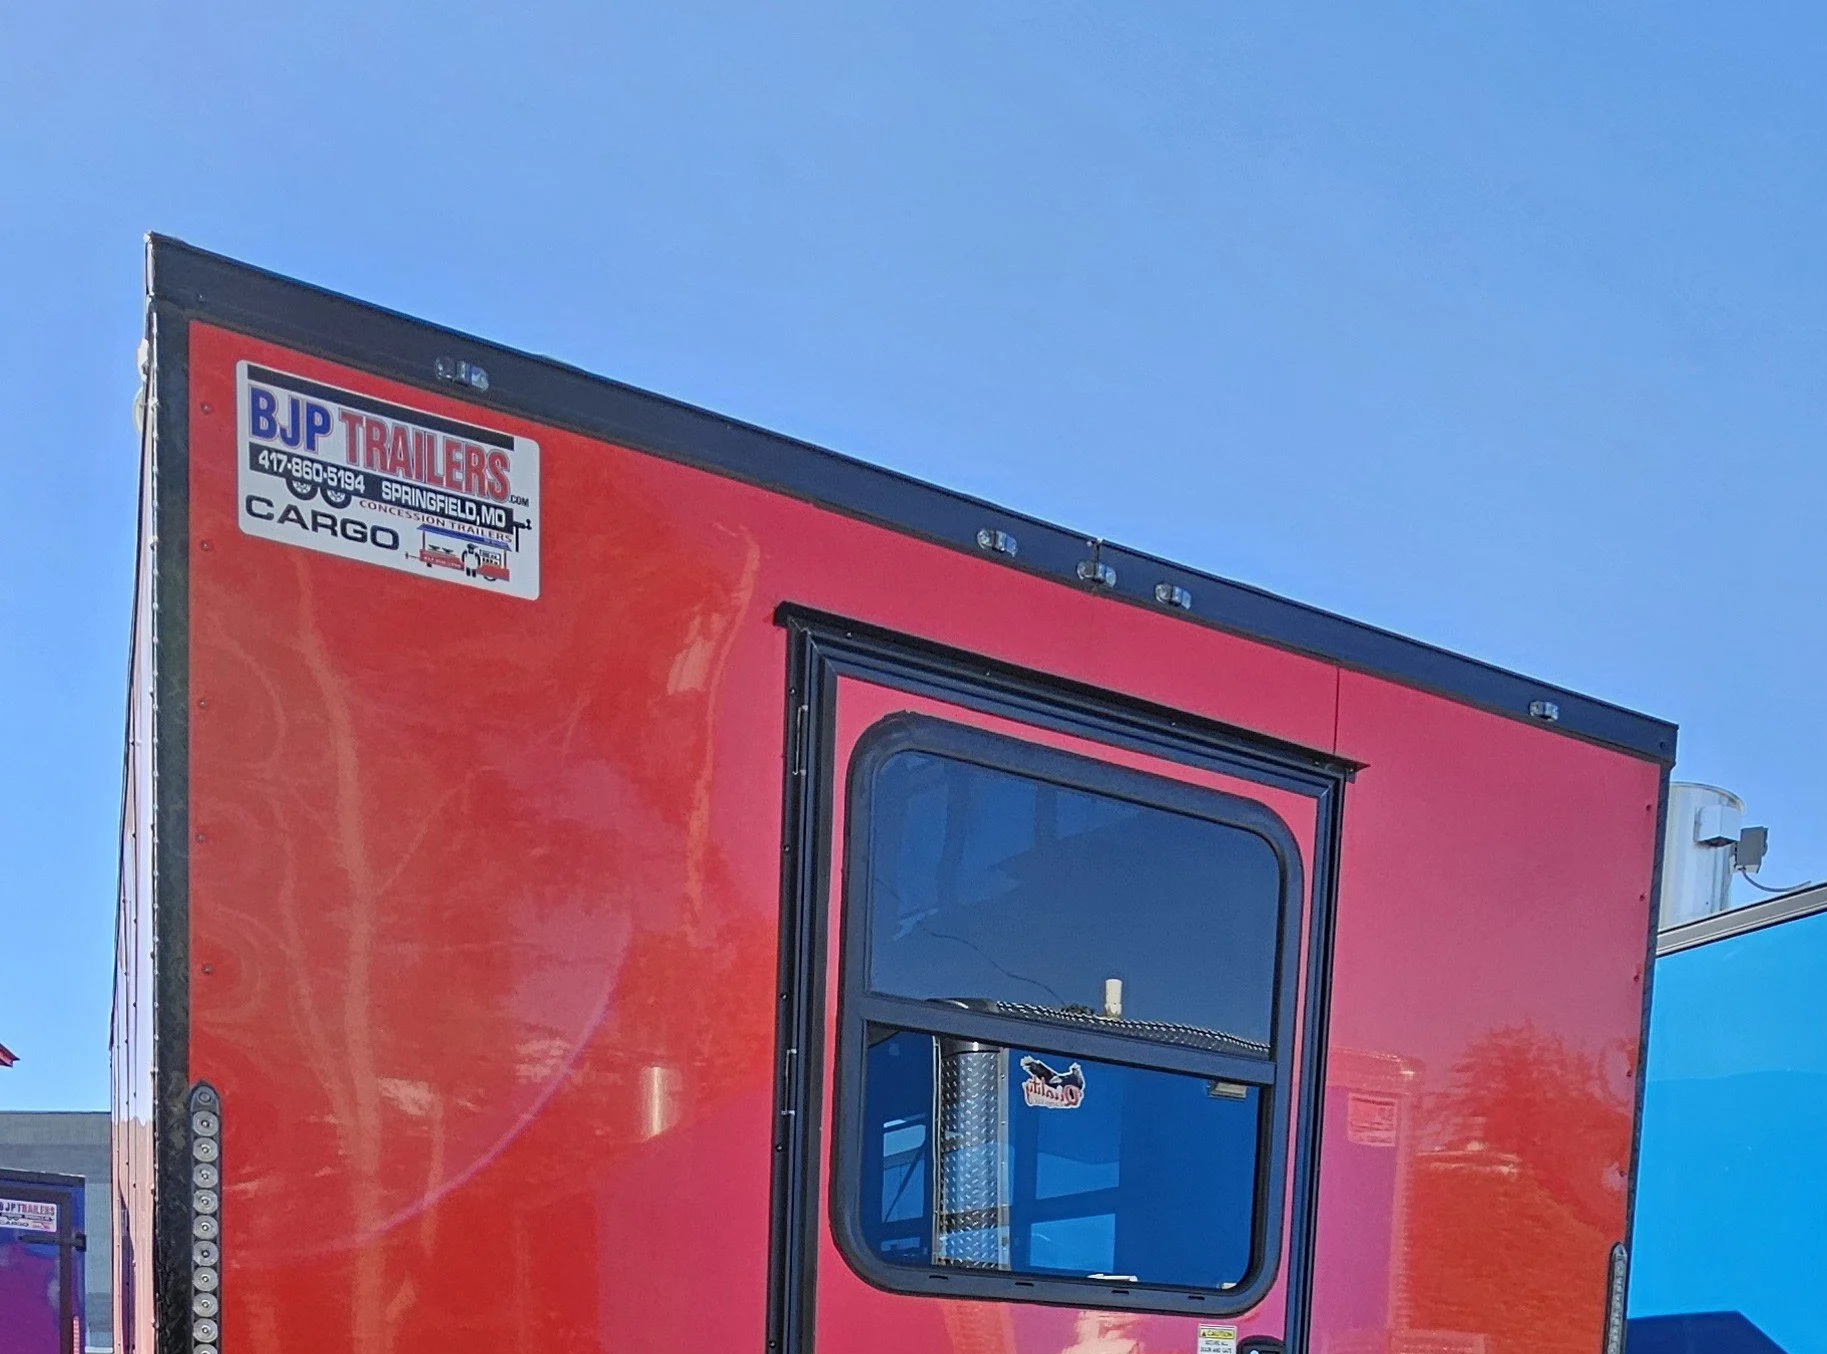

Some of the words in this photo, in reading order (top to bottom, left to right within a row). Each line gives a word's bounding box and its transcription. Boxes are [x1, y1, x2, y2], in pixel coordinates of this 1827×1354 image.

[249, 385, 333, 453] BJP
[339, 407, 511, 503] TRAILERS
[245, 494, 400, 551] CARGO
[359, 499, 446, 527] CONCESSION
[450, 521, 513, 543] TRAILERS
[17, 1203, 54, 1216] TRAILERS
